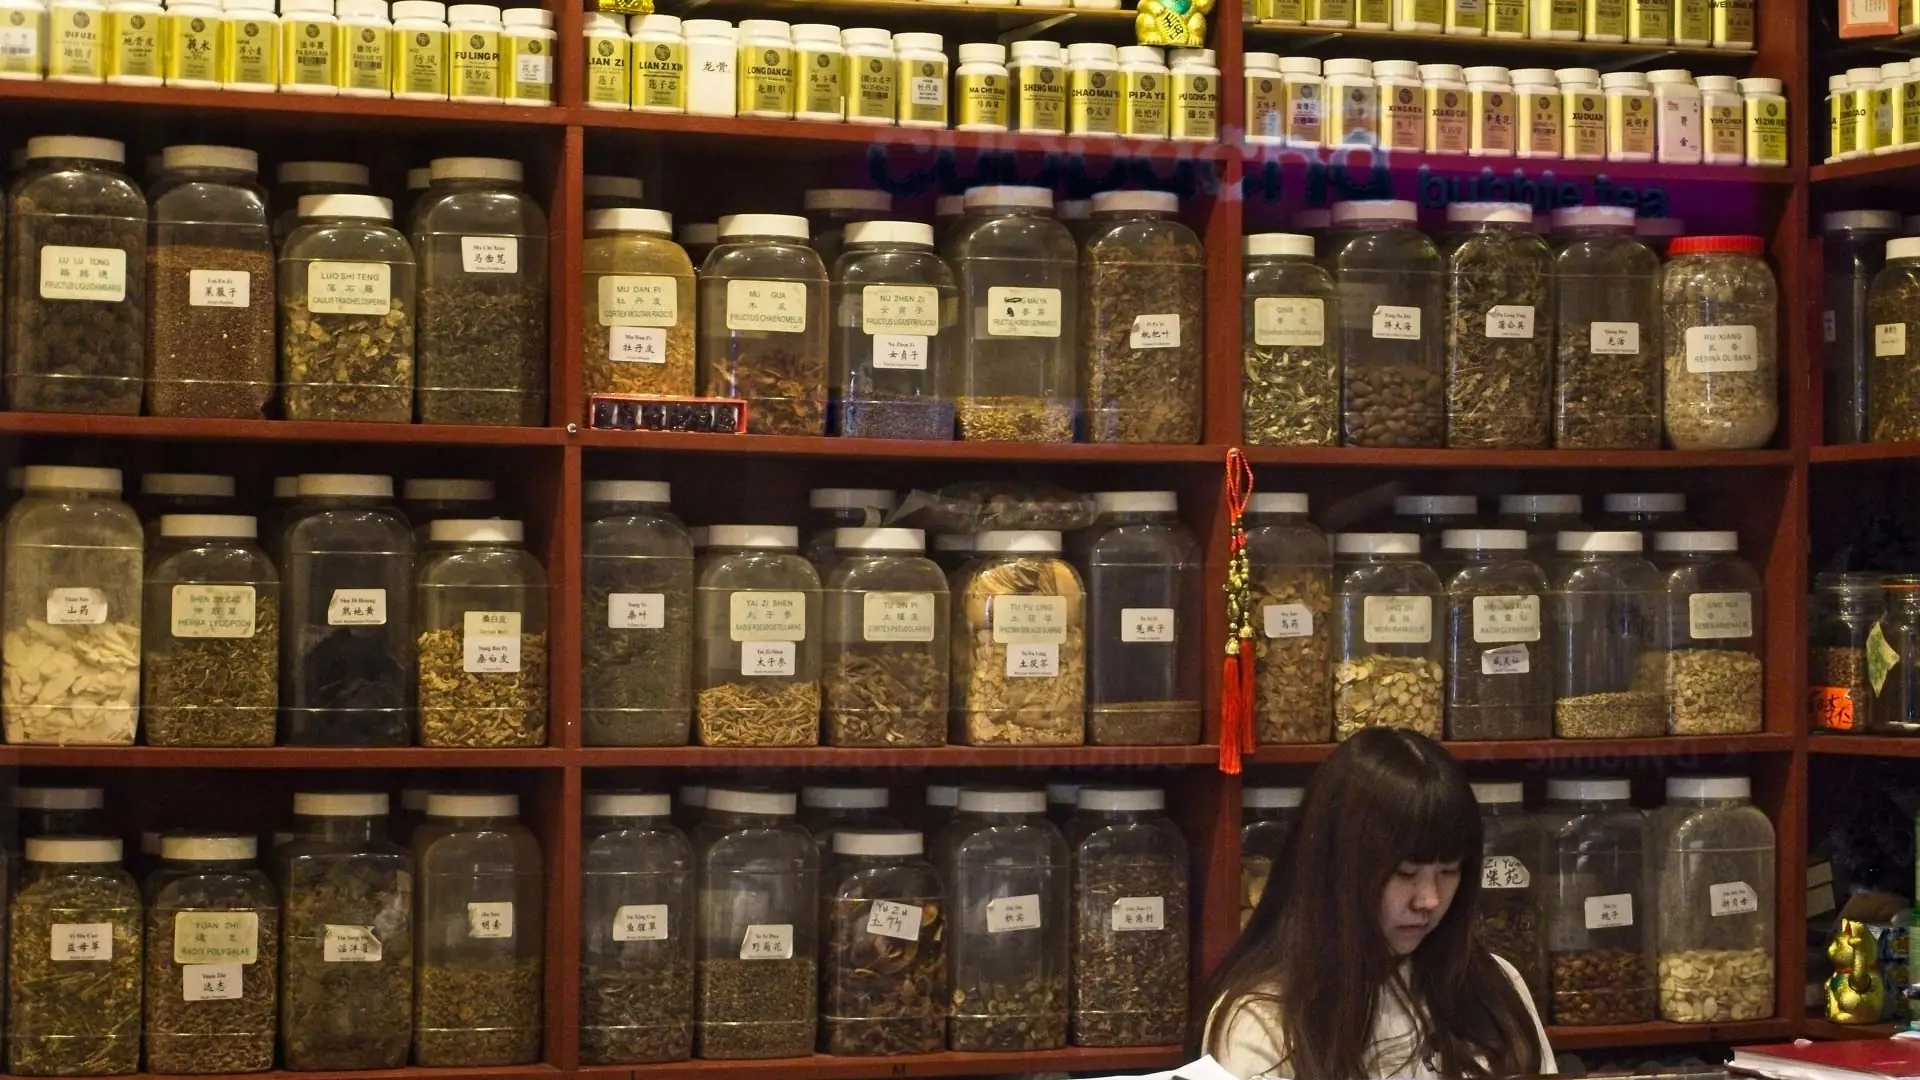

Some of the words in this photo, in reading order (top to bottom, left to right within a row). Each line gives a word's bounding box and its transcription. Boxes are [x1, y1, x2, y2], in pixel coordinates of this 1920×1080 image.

[455, 52, 467, 60] FU
[468, 52, 491, 60] LING
[587, 58, 611, 66] LIAN
[640, 62, 660, 70] LIAN
[661, 62, 670, 70] ZI
[747, 66, 766, 75] LONG
[1154, 92, 1166, 100] YE
[1572, 113, 1583, 121] XU
[321, 273, 339, 281] LUO
[1718, 333, 1742, 341] XIANG
